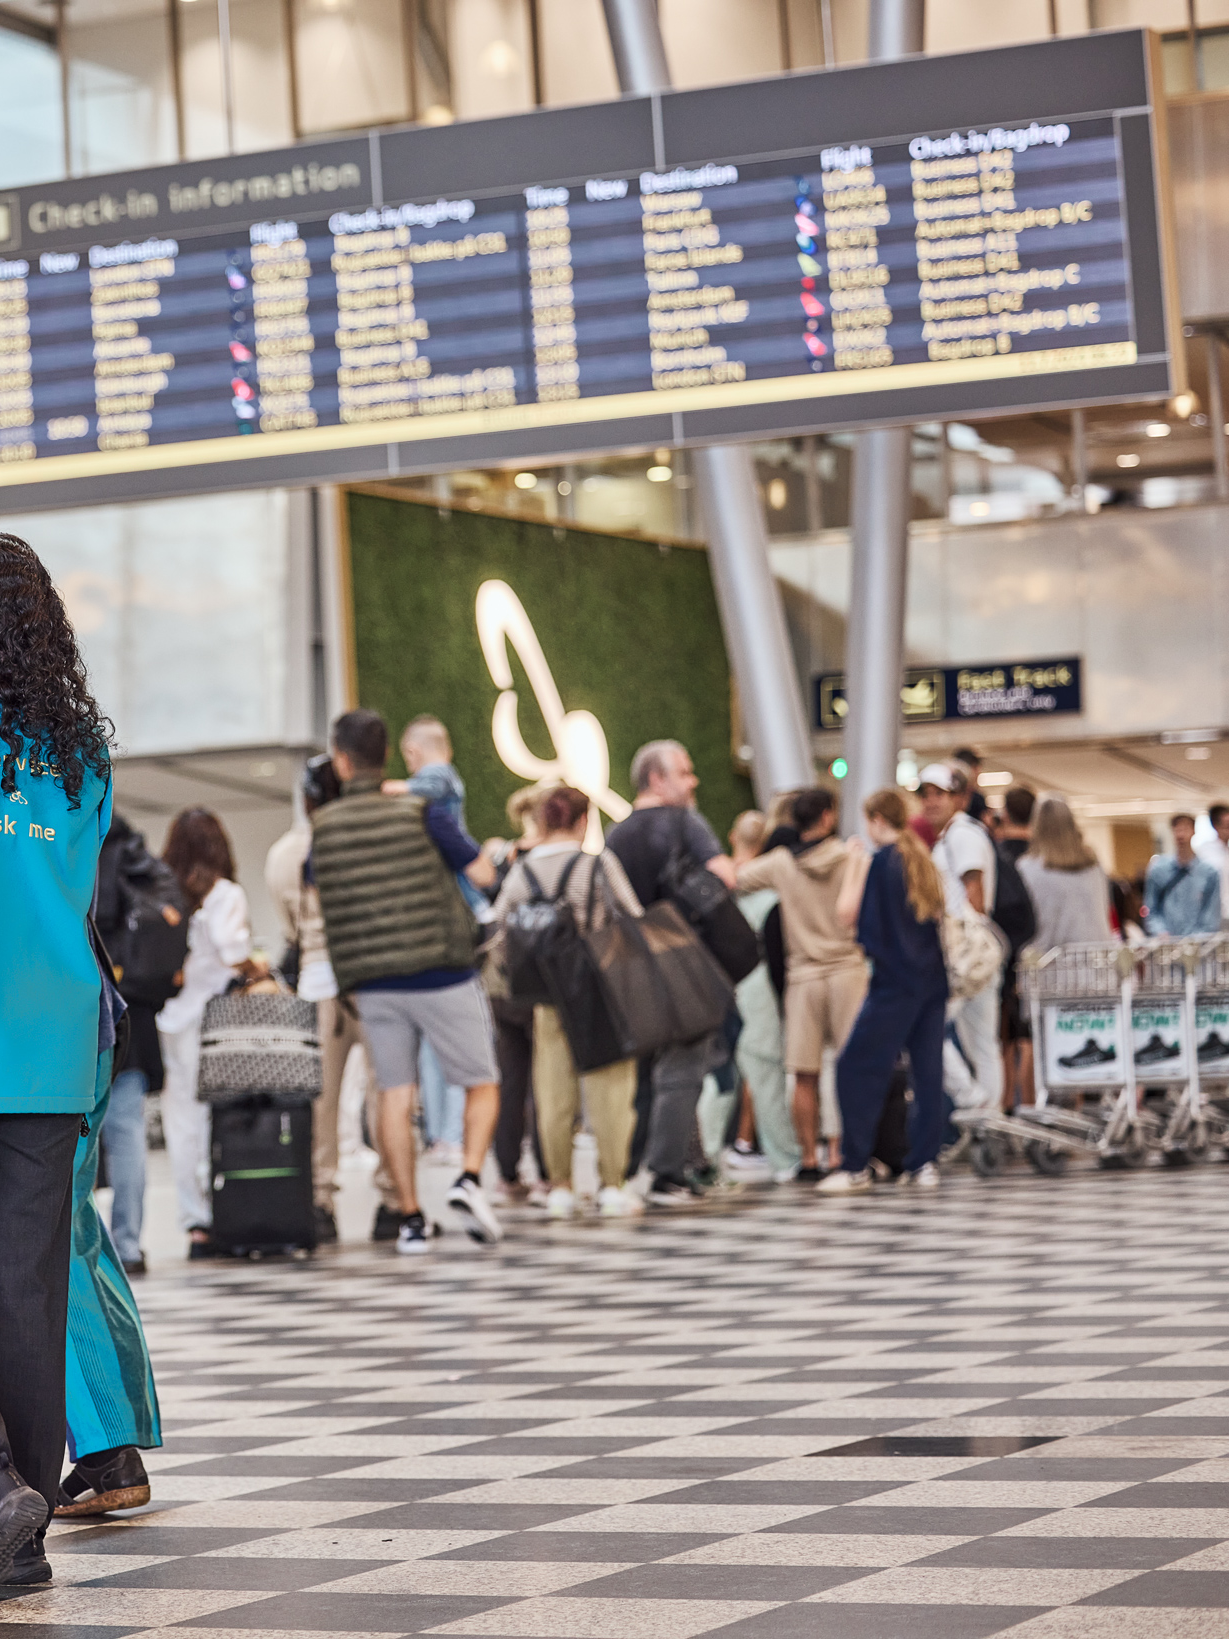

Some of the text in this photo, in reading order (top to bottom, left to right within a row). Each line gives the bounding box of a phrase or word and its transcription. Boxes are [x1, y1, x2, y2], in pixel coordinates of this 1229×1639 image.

[908, 122, 1070, 160] Check-in/Bagdrop
[639, 163, 739, 196] Destination
[28, 161, 361, 234] Check-in information
[957, 665, 1072, 691] Fast Track
[29, 823, 56, 841] me
